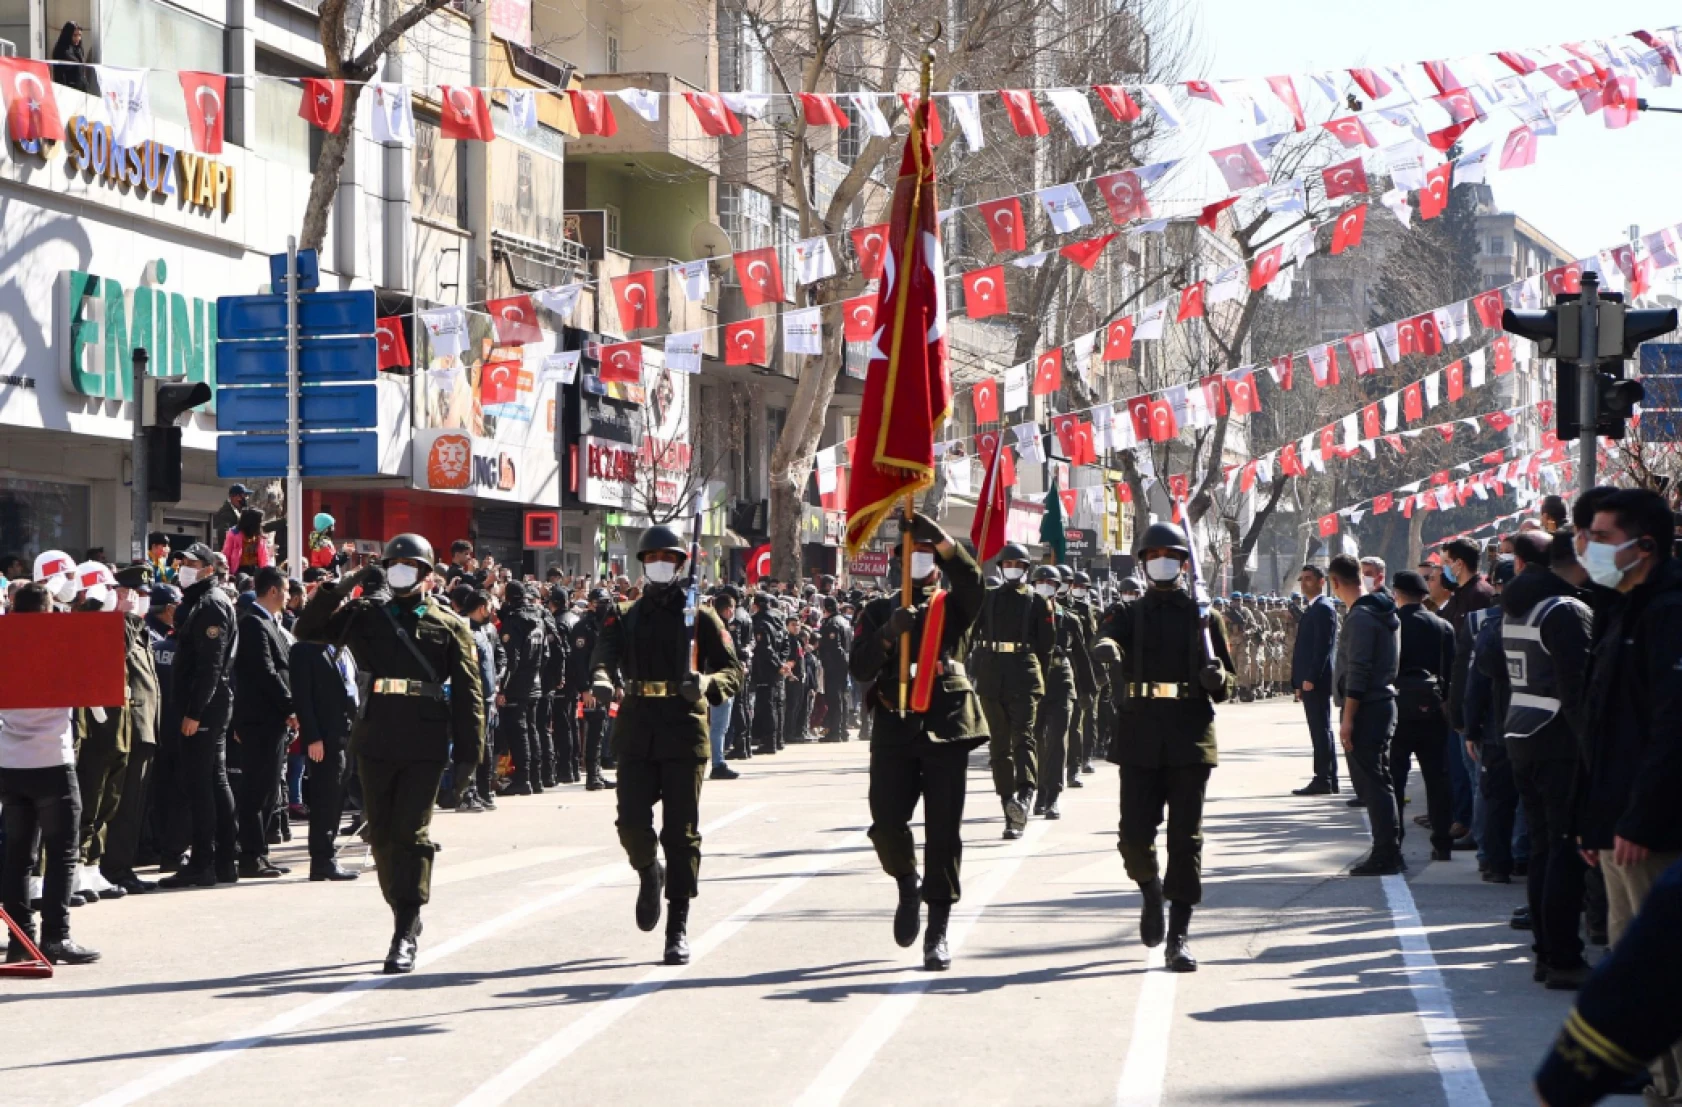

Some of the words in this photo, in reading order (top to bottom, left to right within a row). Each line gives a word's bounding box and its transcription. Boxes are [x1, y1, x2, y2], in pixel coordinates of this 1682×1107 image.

[69, 115, 176, 195] SONSUZ
[178, 150, 236, 215] YAPI
[473, 454, 497, 490] ING
